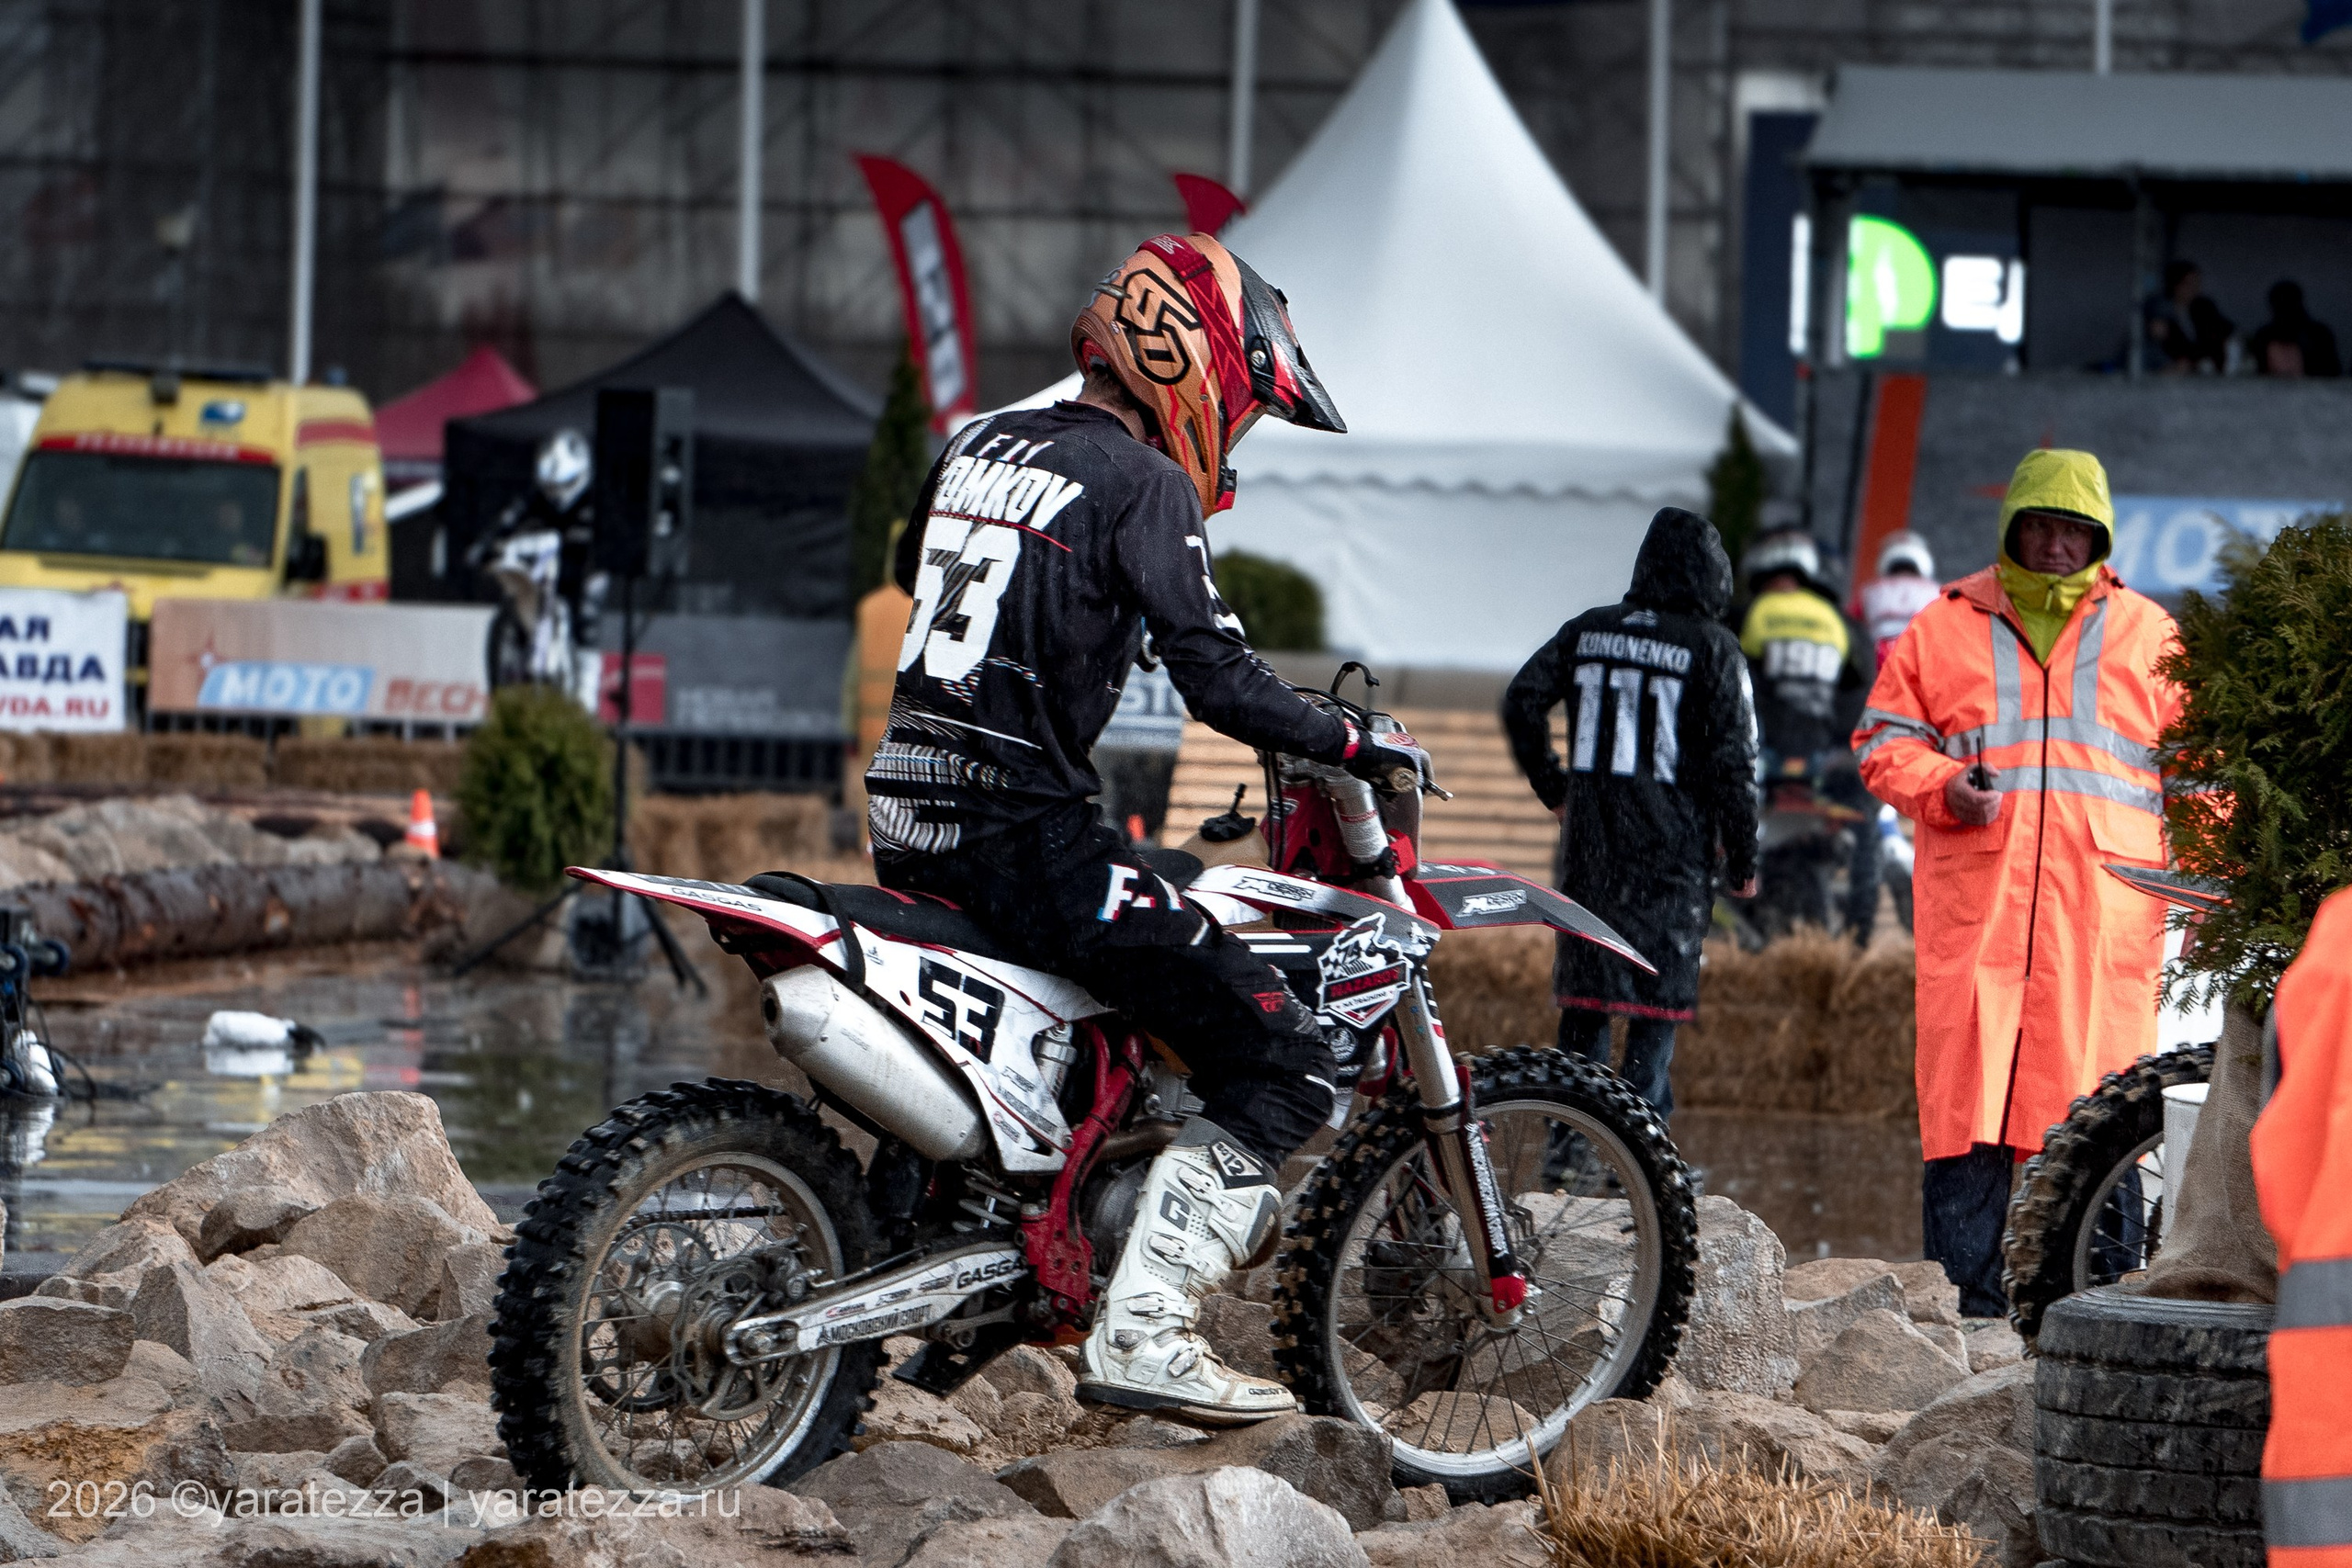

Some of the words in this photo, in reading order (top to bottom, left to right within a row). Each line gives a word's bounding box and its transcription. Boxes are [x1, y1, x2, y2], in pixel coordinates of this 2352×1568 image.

[931, 455, 1084, 531] OMKOV
[898, 516, 1022, 682] 53
[220, 665, 364, 713] МОТО
[1576, 631, 1692, 675] KONONENKO
[1572, 662, 1683, 785] 111
[671, 887, 763, 912] GASGAS
[919, 956, 1005, 1065] 53
